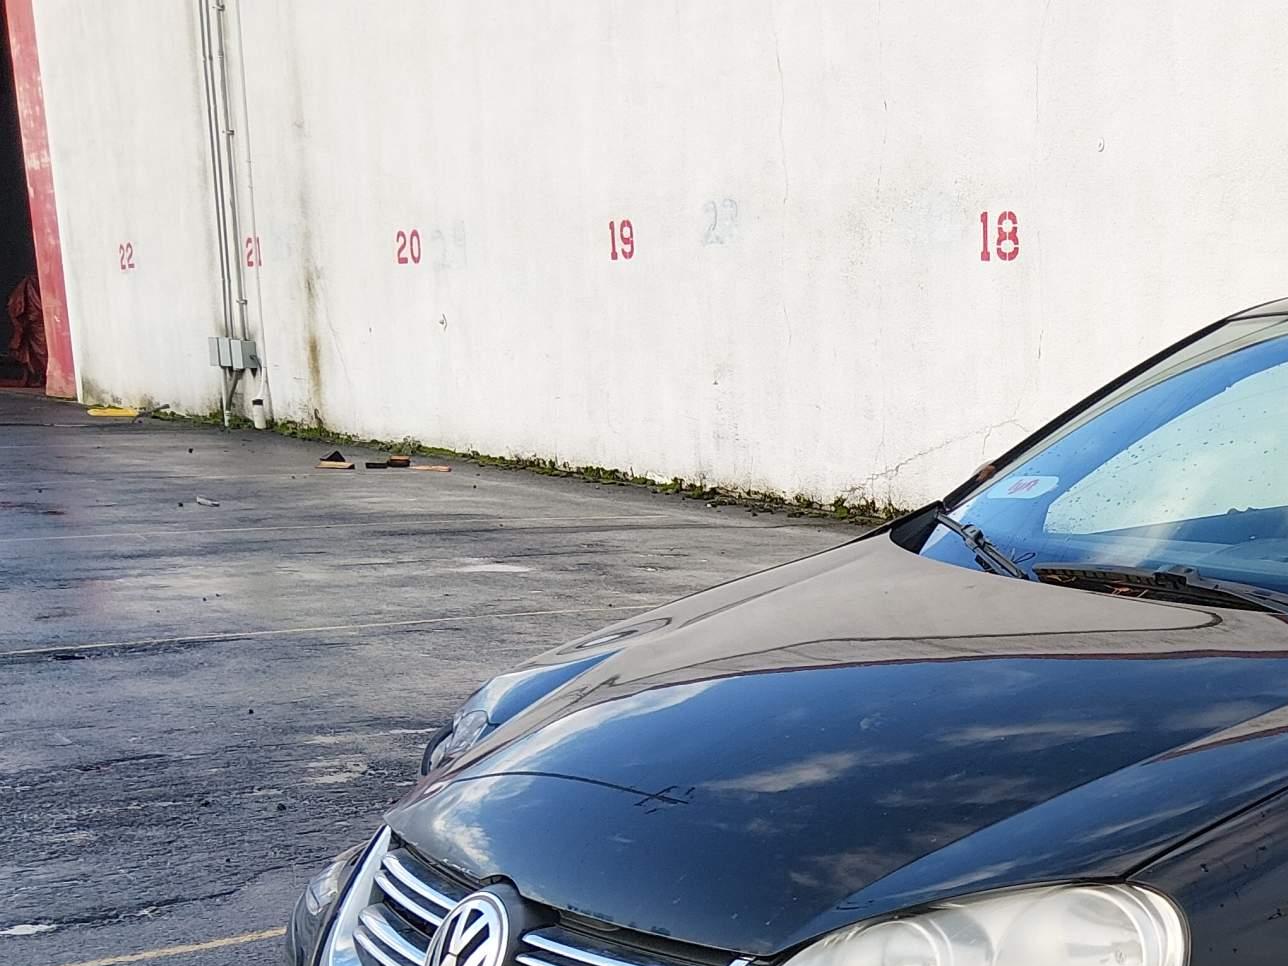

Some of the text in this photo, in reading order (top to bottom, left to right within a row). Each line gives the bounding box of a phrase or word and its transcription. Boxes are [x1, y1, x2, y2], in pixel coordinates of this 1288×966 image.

[246, 237, 262, 267] 21
[396, 229, 421, 264] 20
[608, 219, 635, 261] 19
[980, 211, 1019, 262] 18
[119, 243, 135, 269] 22
